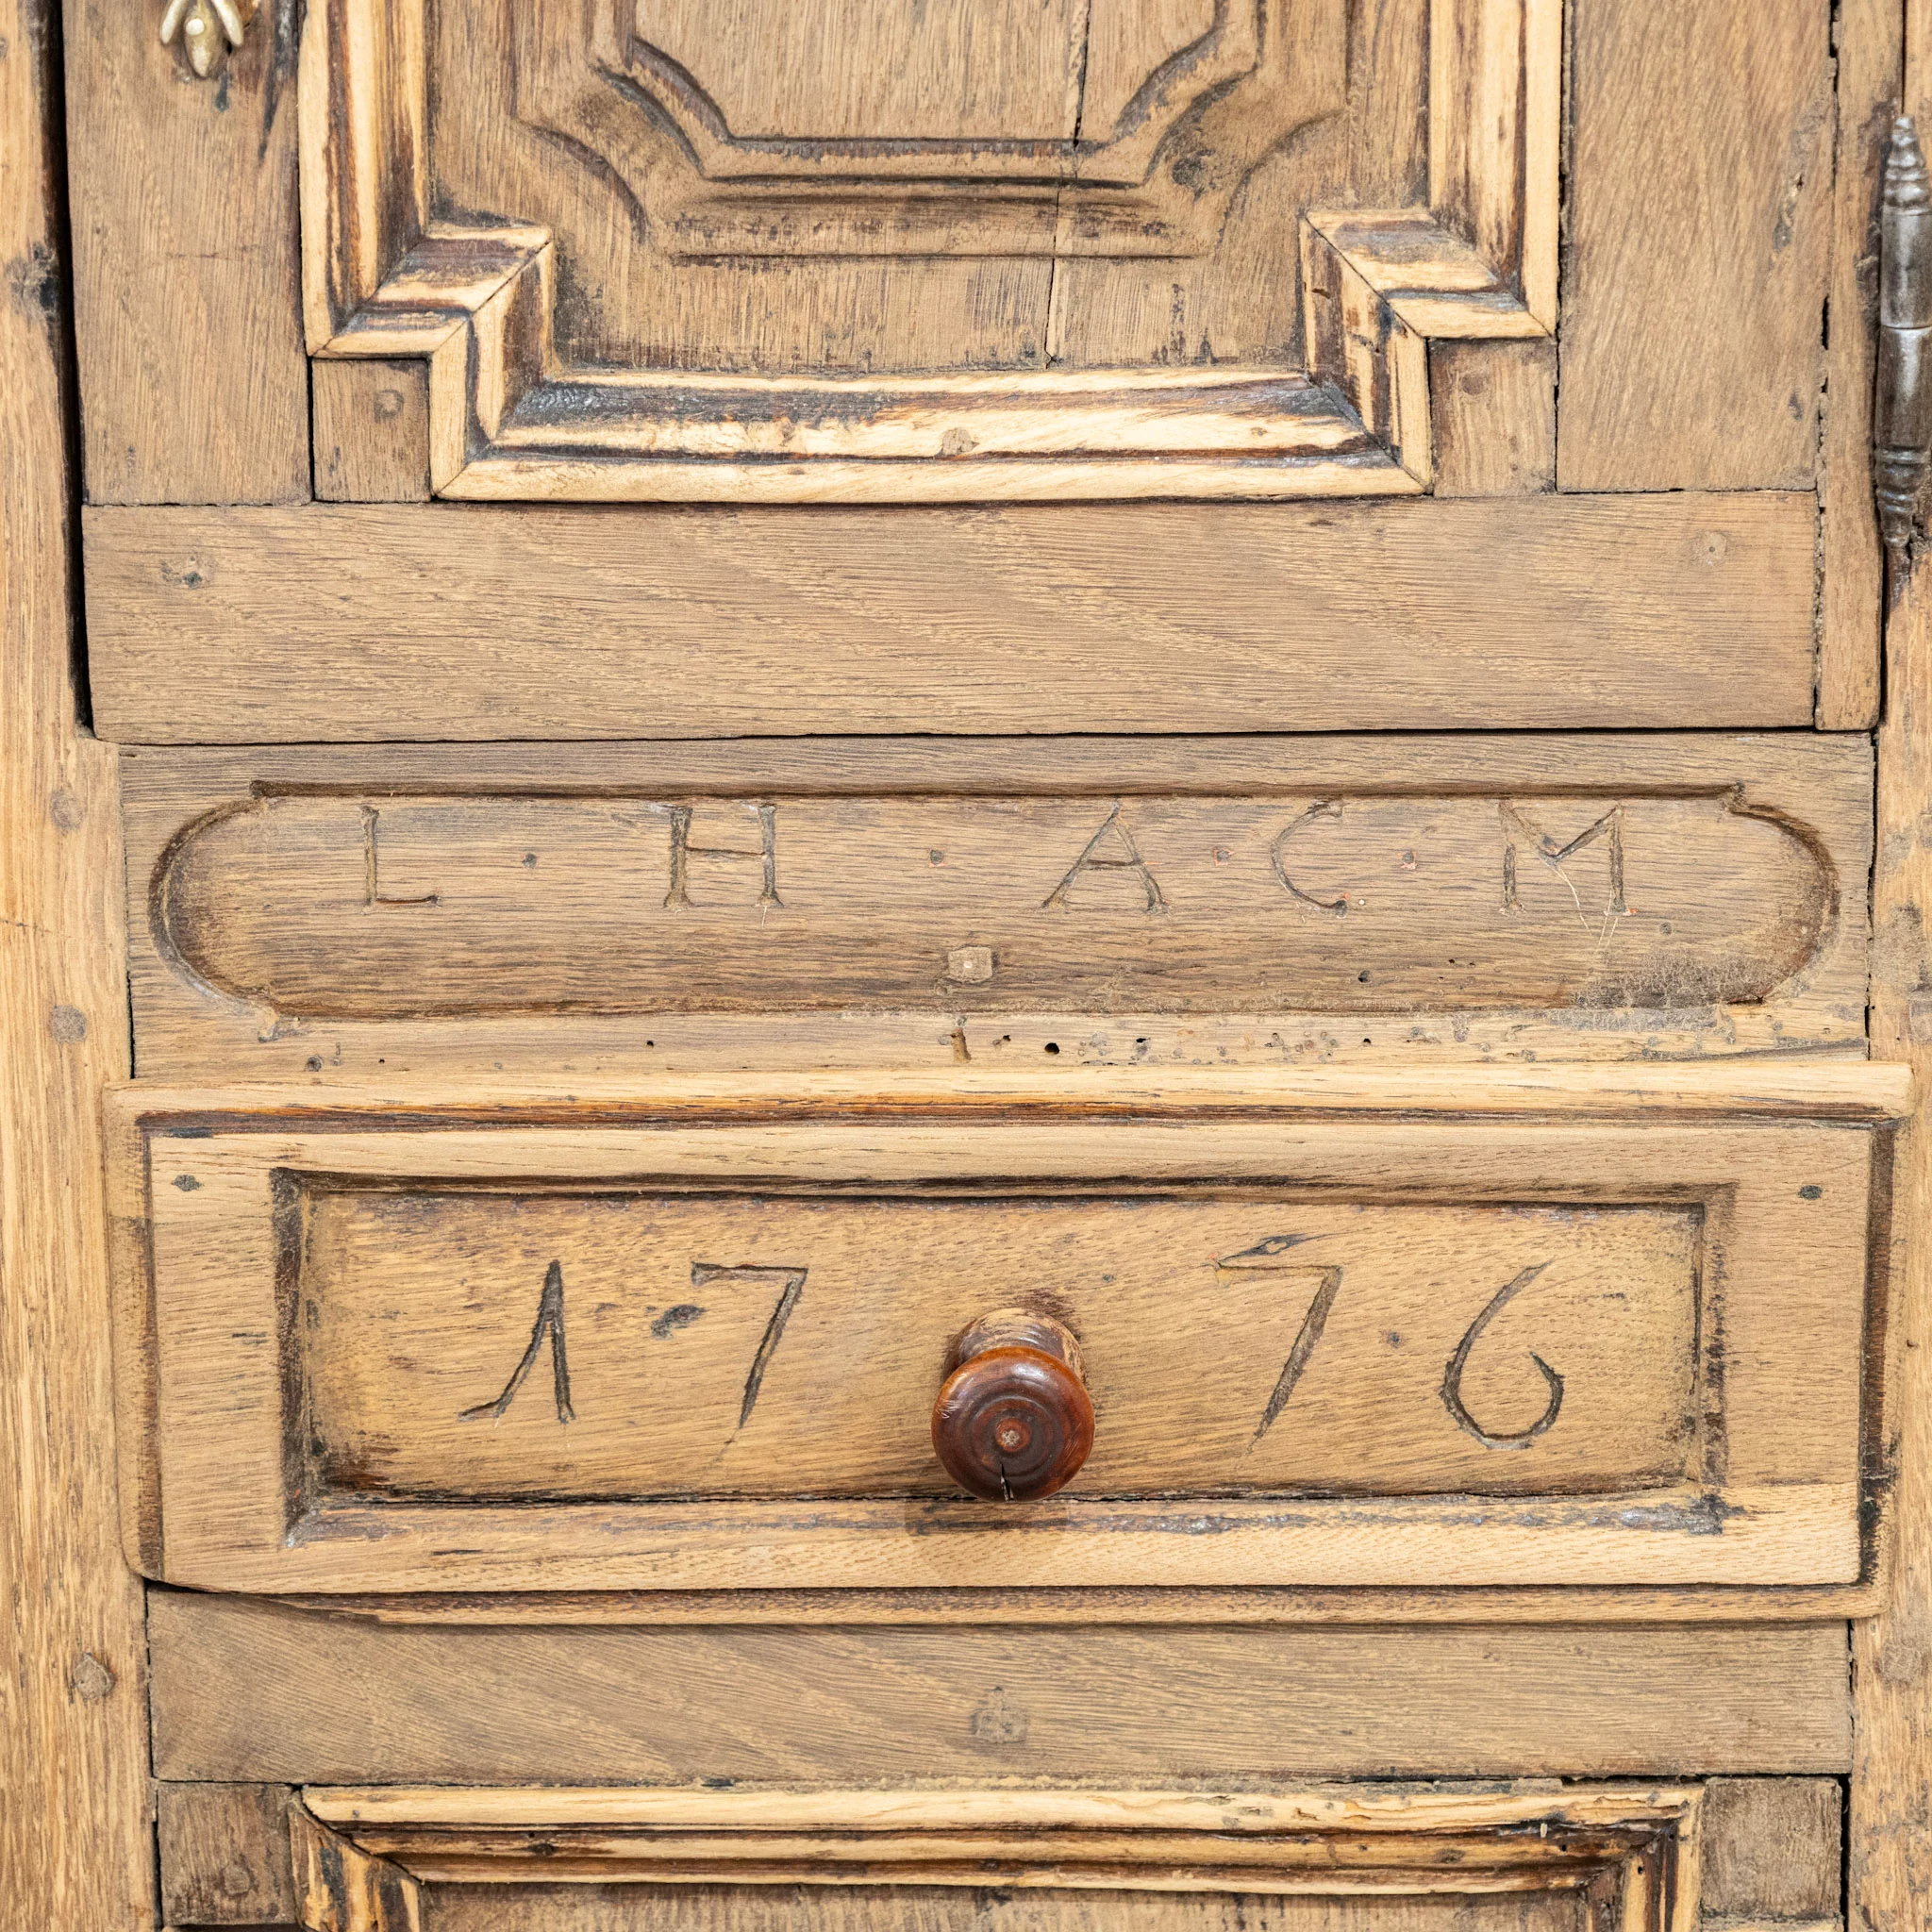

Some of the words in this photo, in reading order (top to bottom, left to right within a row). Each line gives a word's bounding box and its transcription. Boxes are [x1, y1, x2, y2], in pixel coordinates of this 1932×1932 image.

[360, 800, 440, 908] L
[660, 798, 783, 908] H
[1041, 800, 1168, 915] A
[1271, 797, 1348, 917] C
[1498, 800, 1634, 915] M
